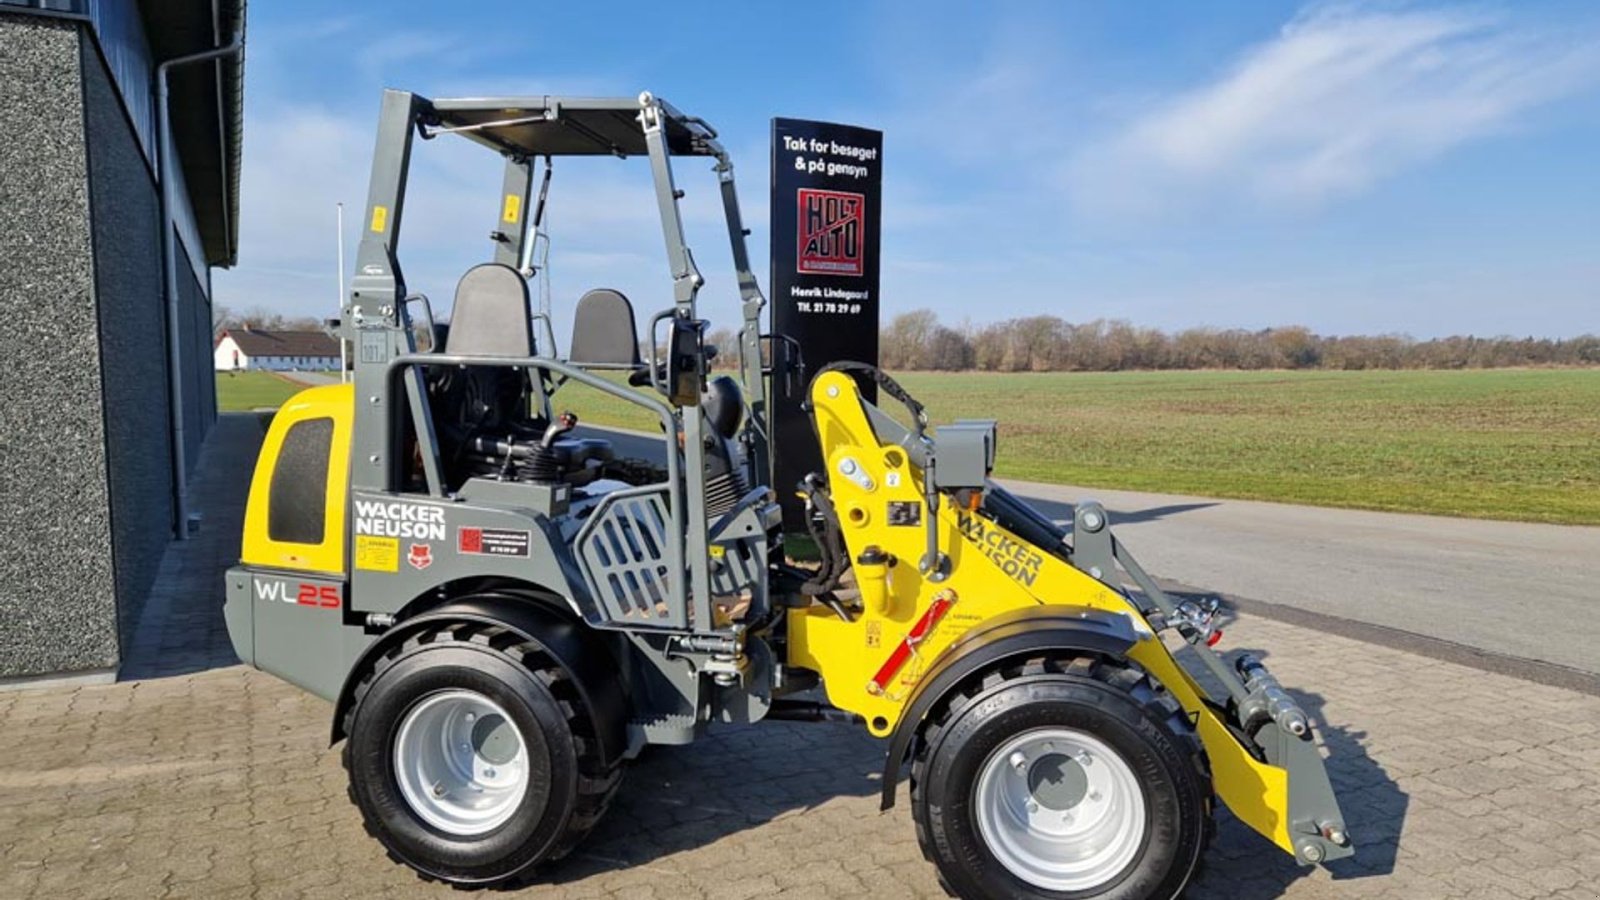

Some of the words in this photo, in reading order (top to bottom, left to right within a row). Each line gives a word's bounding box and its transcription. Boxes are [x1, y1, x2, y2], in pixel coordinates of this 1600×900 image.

[783, 135, 807, 151] Tak
[810, 138, 829, 153] for
[831, 141, 877, 161] besøget
[795, 156, 806, 170] &
[808, 157, 825, 174] på
[827, 163, 868, 179] gensyn
[807, 194, 858, 237] HOLT
[802, 217, 858, 259] AUTO
[791, 286, 822, 297] Henrik
[355, 500, 446, 524] WACKER
[356, 518, 446, 541] NEUSON
[957, 510, 1044, 572] WACKER
[254, 579, 341, 608] WL25
